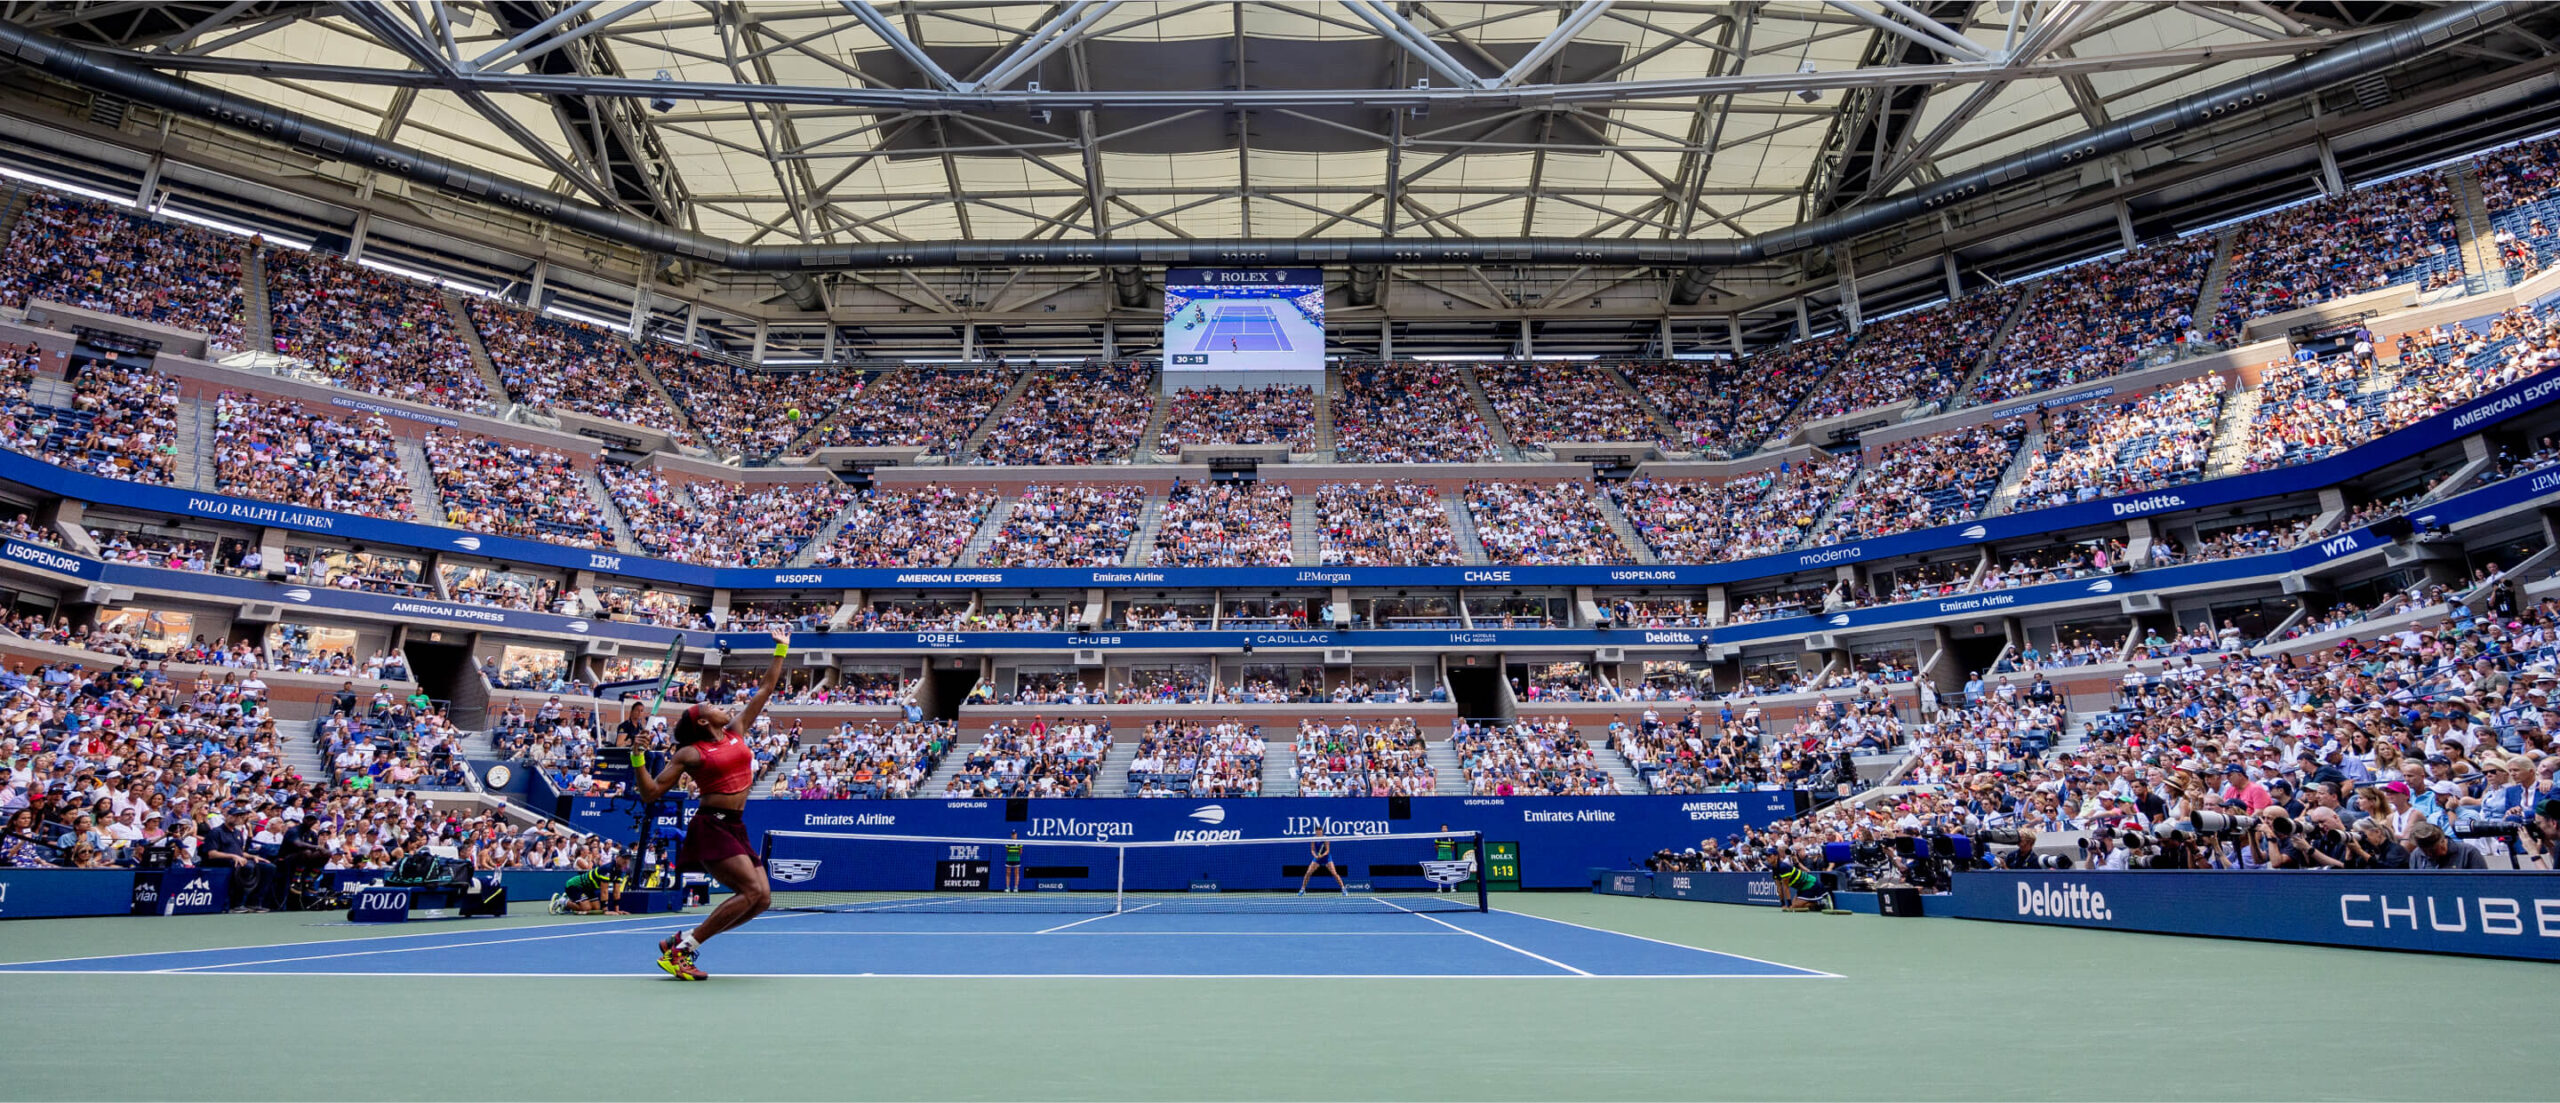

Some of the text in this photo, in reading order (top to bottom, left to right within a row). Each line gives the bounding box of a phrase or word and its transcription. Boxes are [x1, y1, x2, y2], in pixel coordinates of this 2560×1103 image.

[1221, 272, 1269, 282] ROLEX
[332, 397, 458, 427] GUEST CONCERN? TEXT (917)708-8080
[1992, 409, 2013, 418] GUEST
[2014, 402, 2047, 413] CONCE?
[2047, 398, 2064, 407] TEXT
[2453, 392, 2522, 430] AMERICAN
[2531, 471, 2560, 492] J.P.M
[2112, 494, 2185, 516] Deloitte.
[188, 498, 334, 529] POLO RALPH LAUREN
[2321, 535, 2358, 558] WTA
[6, 543, 80, 572] USOPEN.ORG
[589, 553, 621, 570] IBM
[1800, 546, 1861, 566] moderna
[775, 574, 822, 583] #USOPEN
[896, 574, 1002, 583] AMERICAN EXPRESS
[1093, 571, 1164, 582] Emirates Airline
[1296, 571, 1351, 583] J.P.Morgan
[1464, 571, 1512, 582] CHASE
[1611, 571, 1676, 580] USOPEN.ORG
[1940, 593, 2014, 612] Emirates Airline
[392, 602, 505, 622] AMERICAN EXPRESS
[1068, 636, 1121, 645] CHUBB
[1257, 635, 1328, 643] CADILLAC
[1450, 633, 1471, 643] IHG
[1645, 631, 1694, 643] Deloitte.
[1682, 801, 1738, 812] AMERICAN
[804, 813, 895, 825] Emirates Airline
[1523, 809, 1616, 822] Emirates Airline
[1690, 811, 1740, 820] EXPRESS
[1027, 818, 1134, 842] J.P.Morgan
[1283, 817, 1390, 837] J.P.Morgan
[1174, 829, 1241, 843] us open
[949, 845, 980, 859] IBM
[949, 863, 966, 878] 111
[1492, 865, 1514, 877] 1:13
[1673, 877, 1692, 889] DOBEL
[176, 890, 212, 907] evian
[360, 892, 407, 910] POLO
[2017, 881, 2112, 921] Deloitte.
